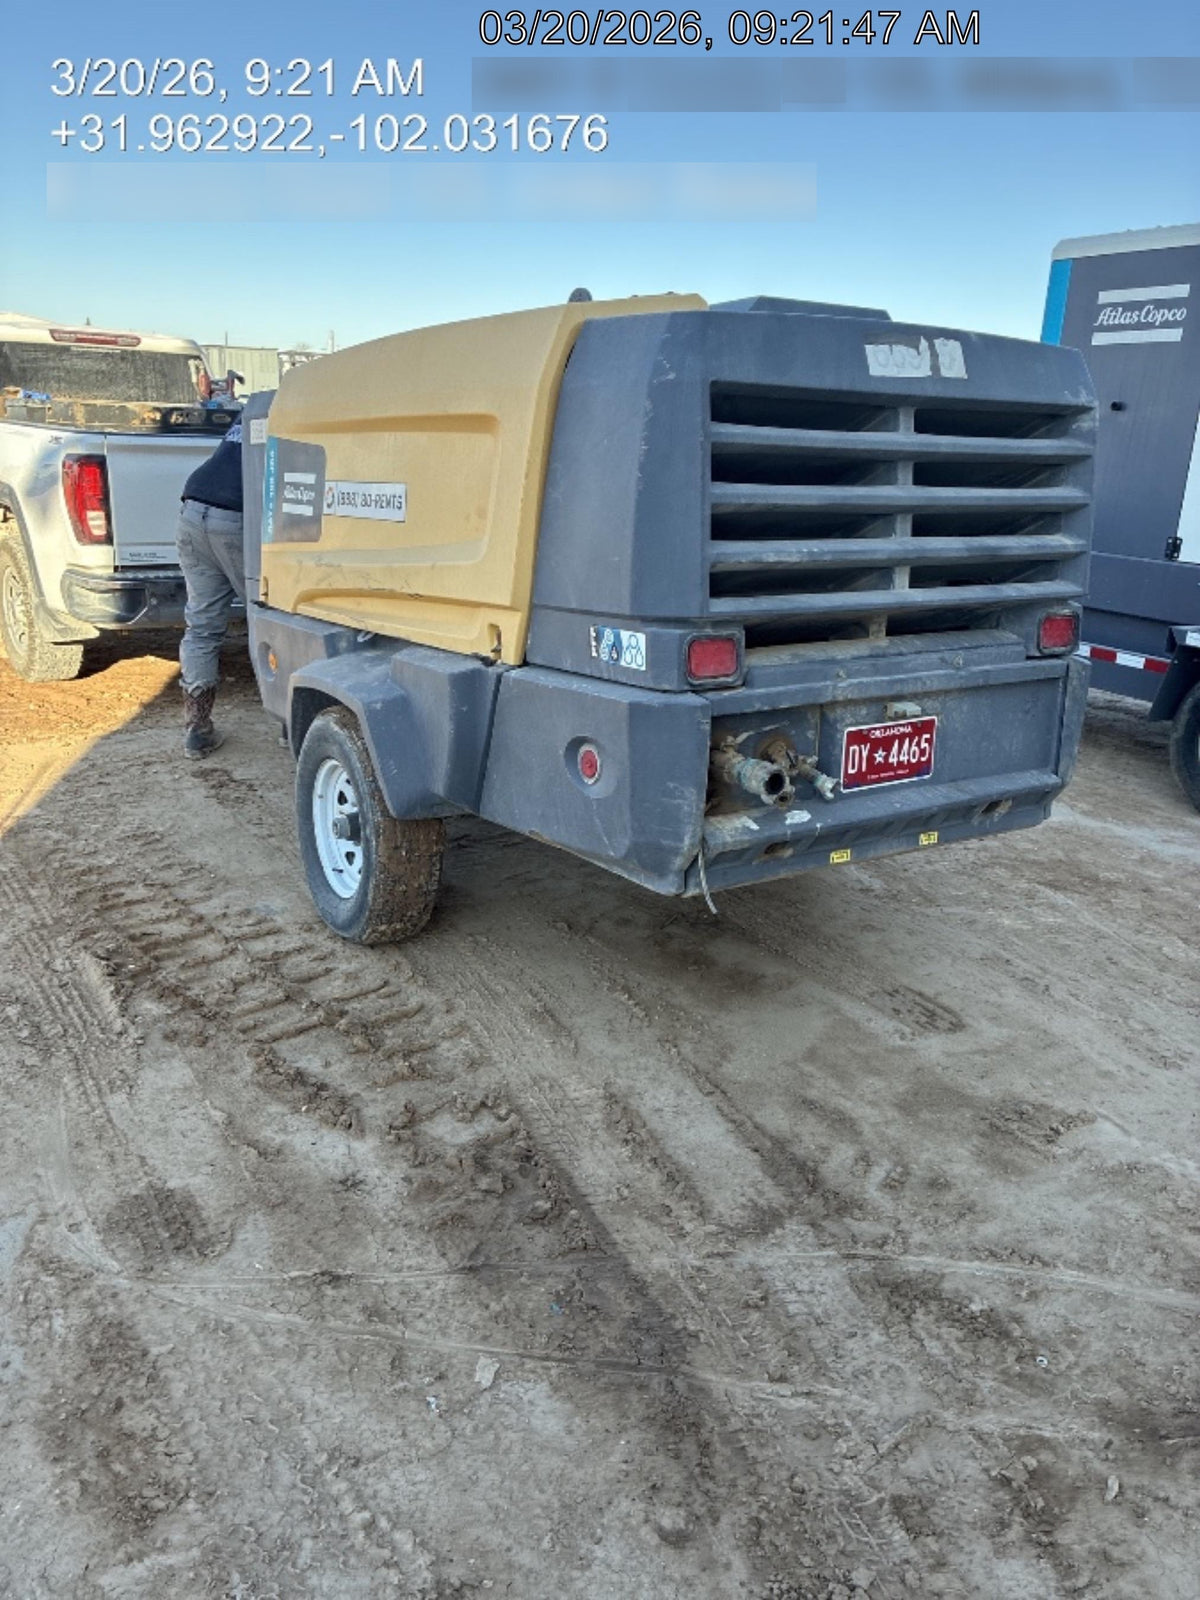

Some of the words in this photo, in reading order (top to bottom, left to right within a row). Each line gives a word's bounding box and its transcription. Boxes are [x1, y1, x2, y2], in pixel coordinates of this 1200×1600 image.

[869, 725, 913, 739] OKLAHOMA
[847, 742, 871, 775] DY
[888, 733, 931, 767] 4465
